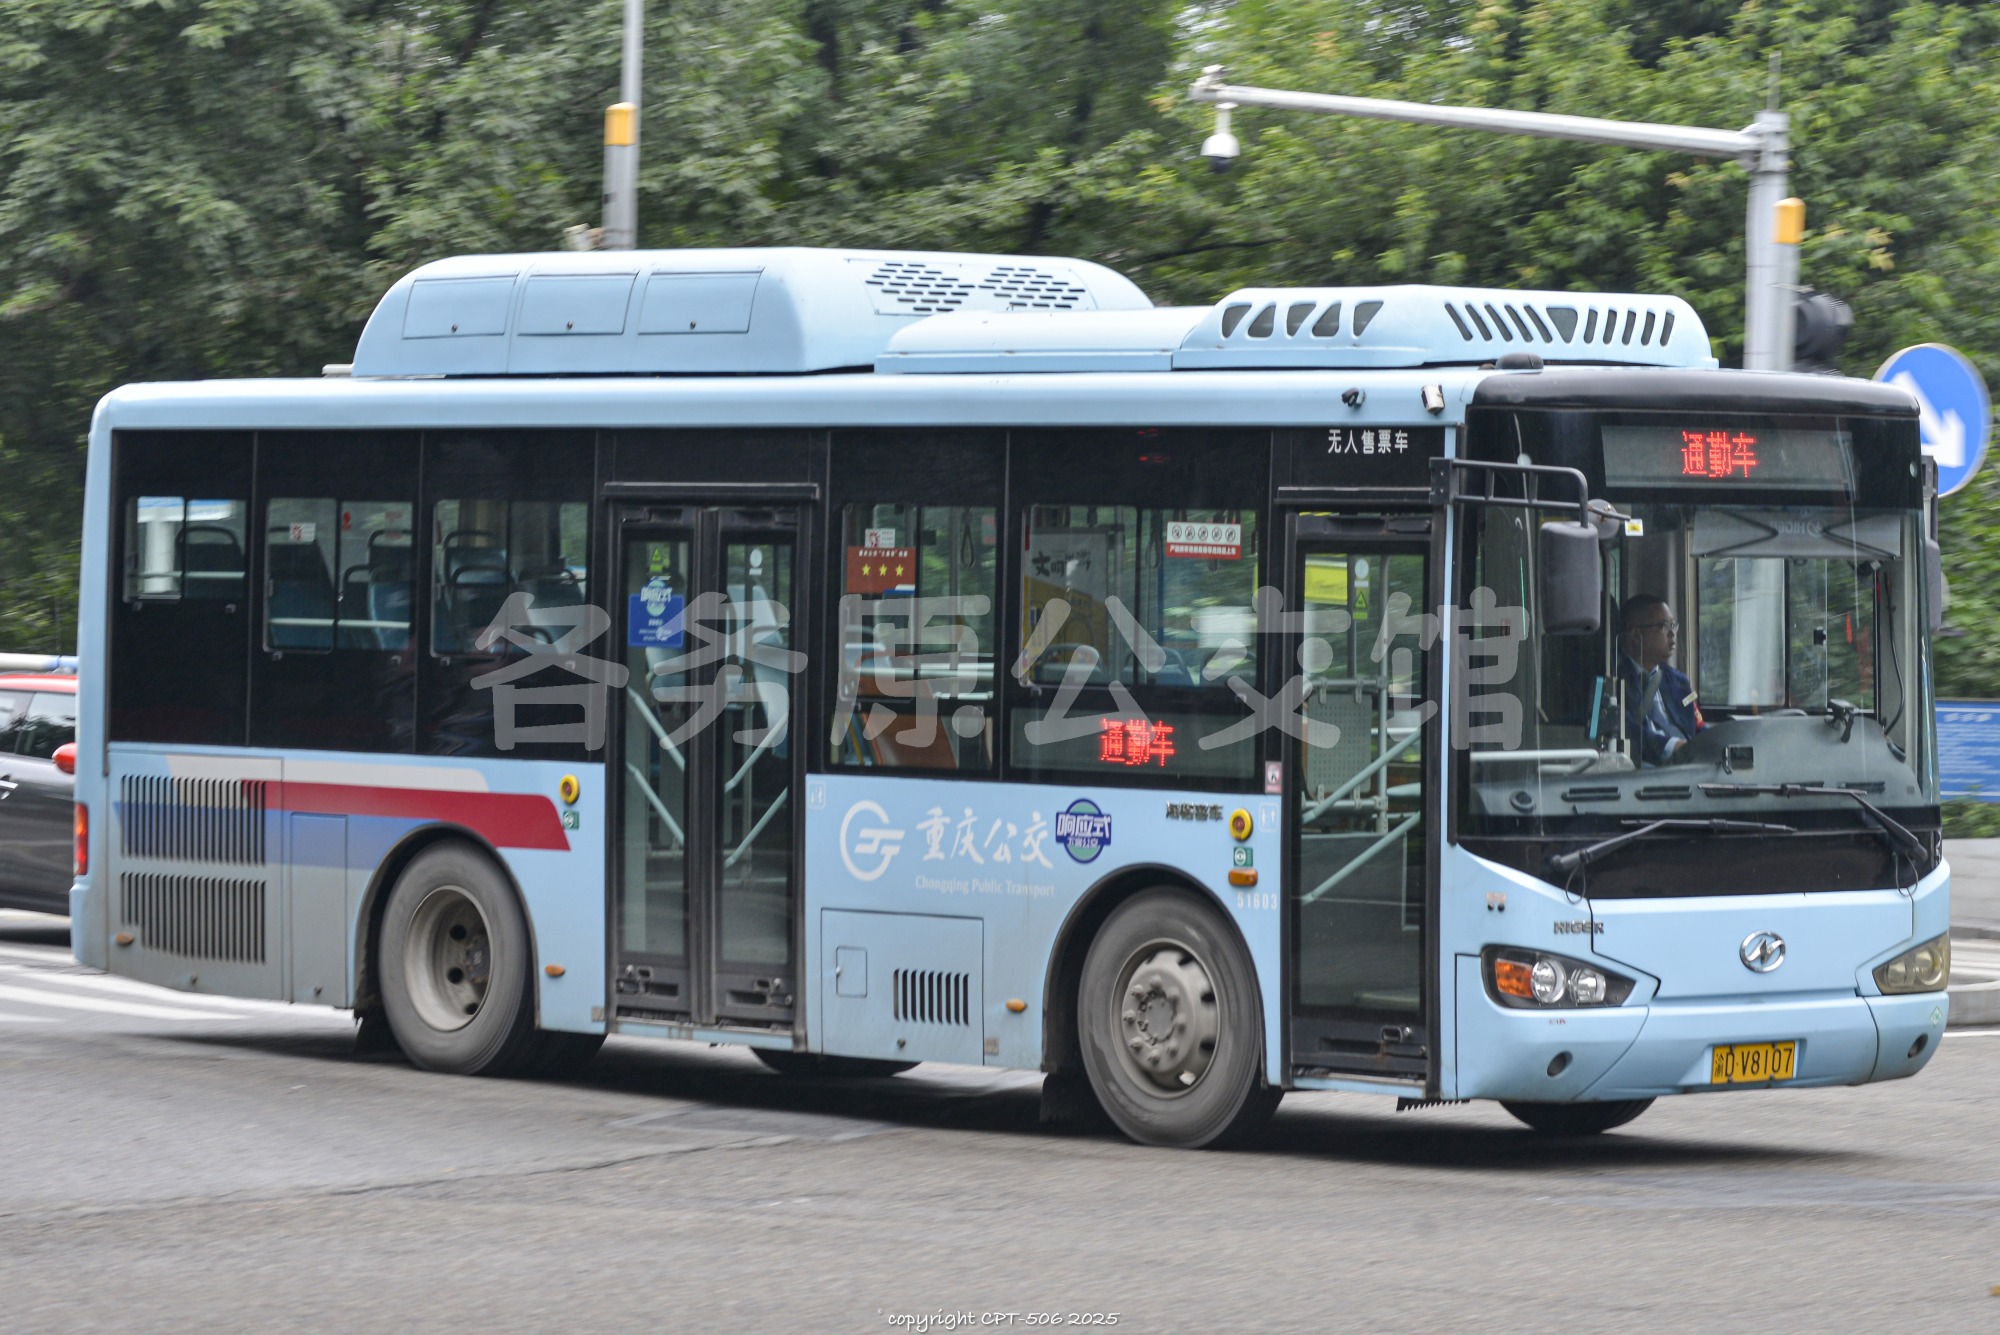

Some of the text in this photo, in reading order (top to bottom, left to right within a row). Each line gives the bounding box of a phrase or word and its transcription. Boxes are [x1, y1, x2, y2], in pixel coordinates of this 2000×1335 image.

[1328, 429, 1408, 454] 无人售票车
[1681, 431, 1757, 478] 通勤车
[1101, 718, 1175, 767] 通勤车
[916, 807, 1053, 869] 重庆公交
[1057, 813, 1111, 839] 响应式
[915, 875, 1055, 898] Chongqing Public Transport
[1237, 892, 1278, 910] 51603
[1553, 920, 1604, 934] HIGER
